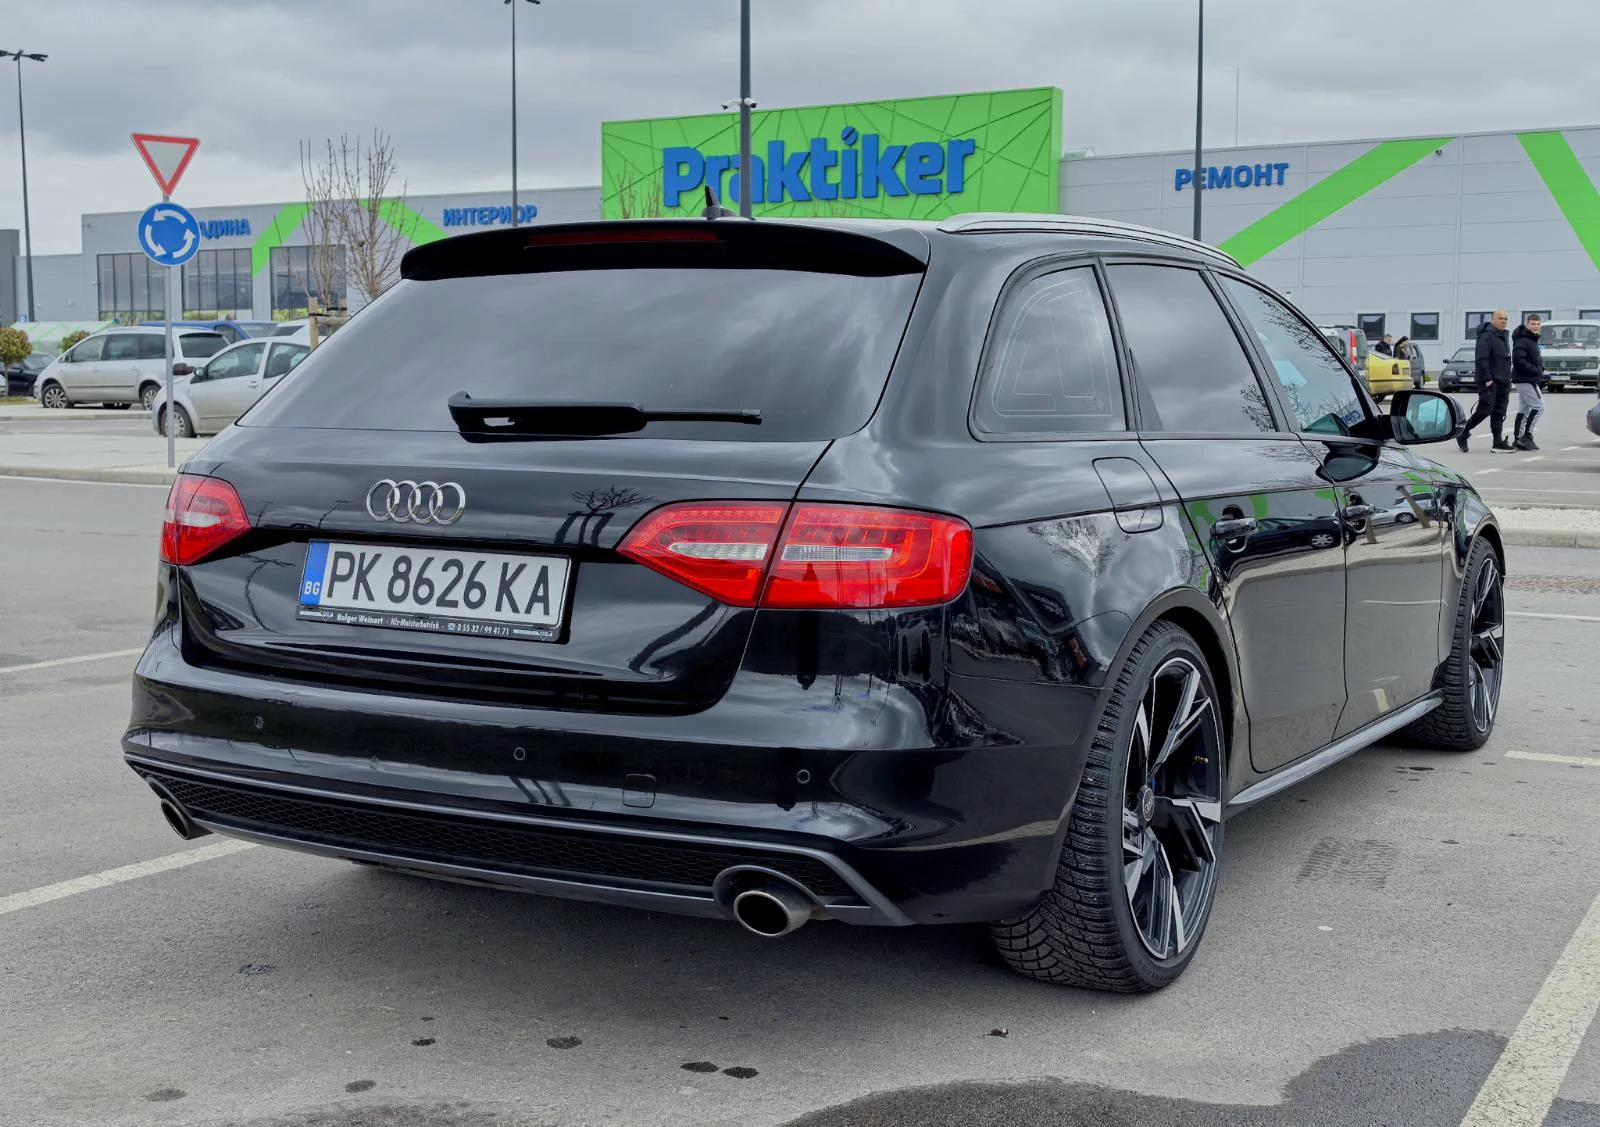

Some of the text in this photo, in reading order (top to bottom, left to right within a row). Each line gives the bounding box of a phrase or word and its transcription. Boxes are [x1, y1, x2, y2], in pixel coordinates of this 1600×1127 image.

[662, 125, 976, 208] Praktiker
[443, 205, 538, 227] ИНТЕРИОР
[304, 550, 551, 616] BG PK 8626 KA
